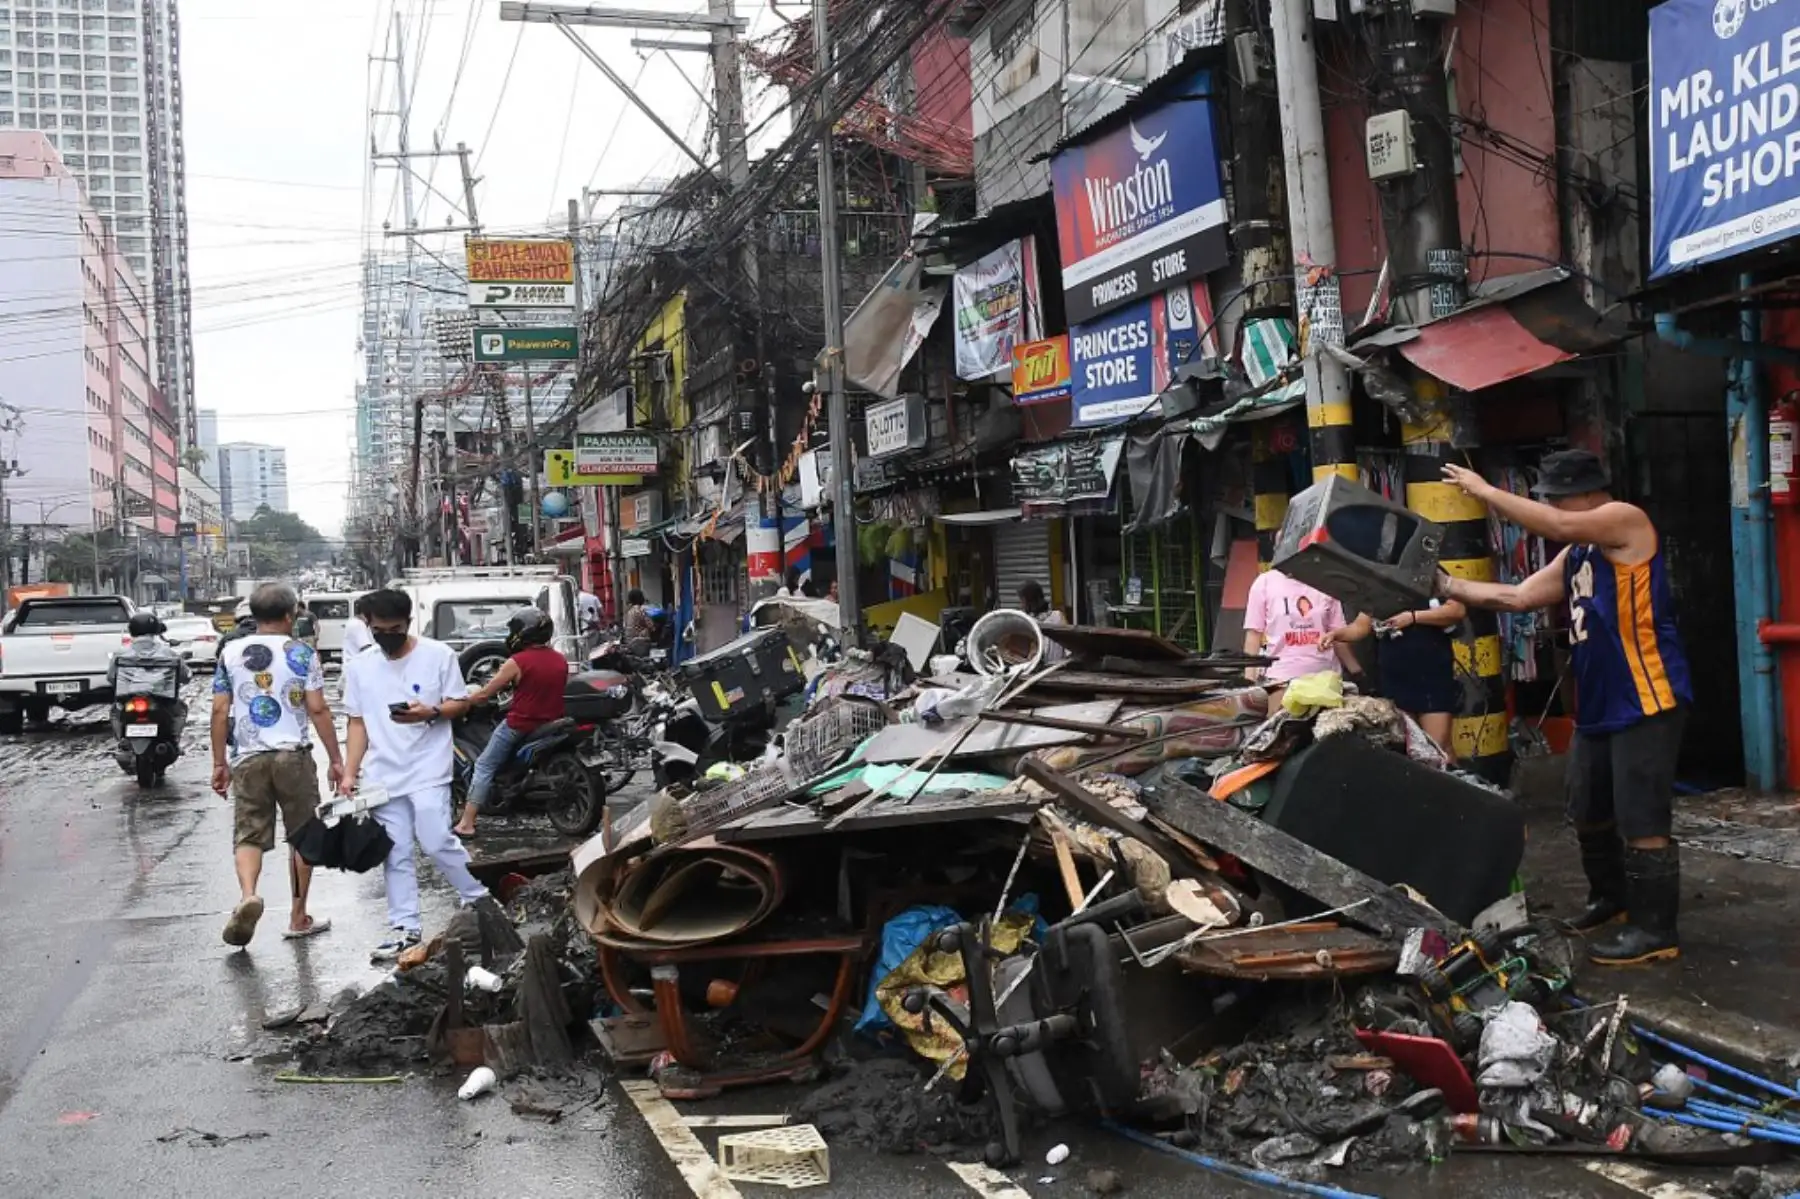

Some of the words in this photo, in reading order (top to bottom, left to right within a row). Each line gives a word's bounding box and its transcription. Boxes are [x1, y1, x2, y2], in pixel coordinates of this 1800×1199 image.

[1661, 69, 1724, 128] MR.
[1669, 82, 1799, 173] LAUND
[1085, 158, 1173, 236] Winston
[488, 243, 568, 261] PALAWAN
[471, 261, 569, 280] PAWNSHOP
[1092, 270, 1139, 307] PRINCESS
[1152, 249, 1188, 283] STORE
[508, 339, 571, 351] PalawanPay
[1074, 320, 1148, 363] PRINCESS
[1024, 346, 1058, 383] TNT
[1086, 355, 1138, 390] STORE
[584, 436, 651, 447] PAANAKAN
[580, 464, 609, 473] CLINIC
[611, 464, 657, 473] MANAGER
